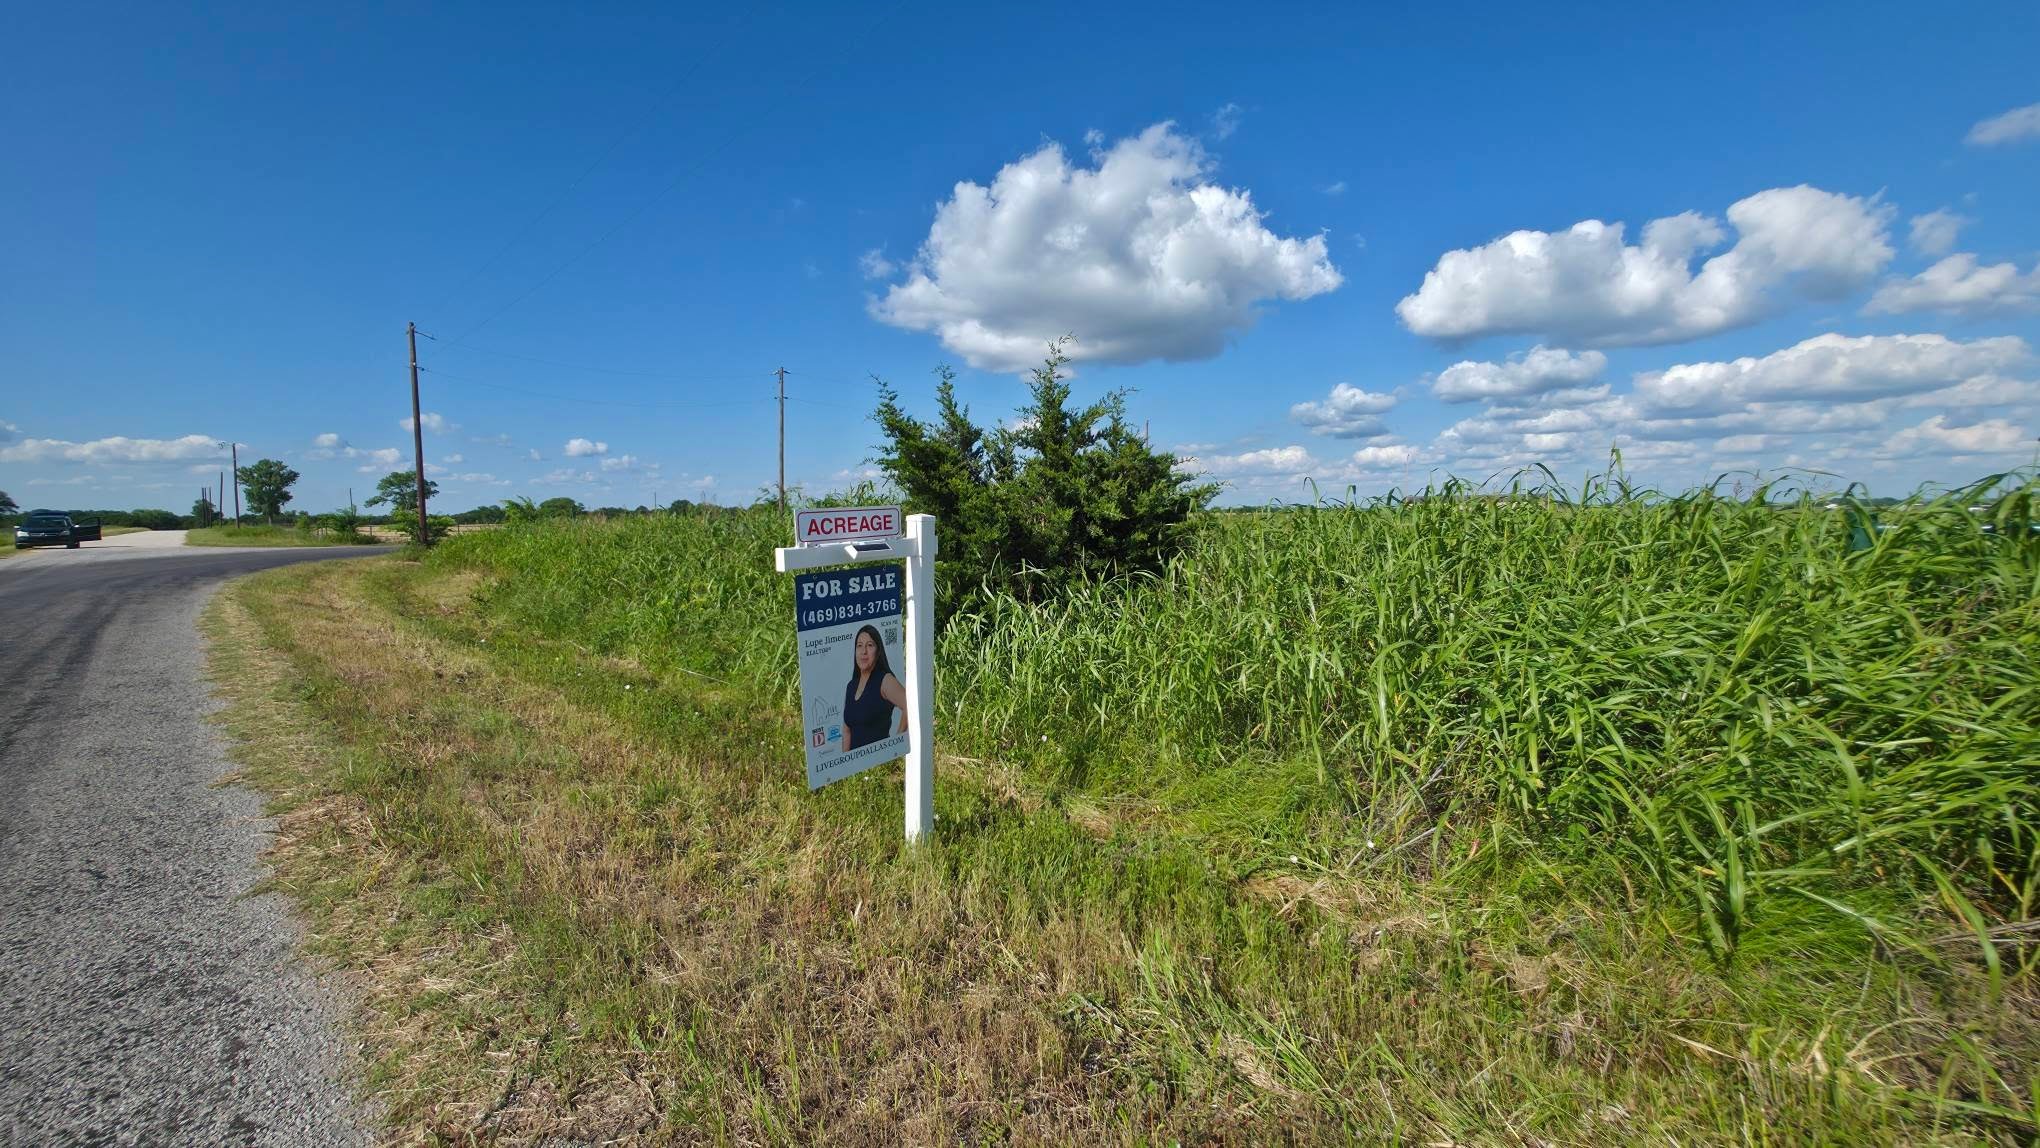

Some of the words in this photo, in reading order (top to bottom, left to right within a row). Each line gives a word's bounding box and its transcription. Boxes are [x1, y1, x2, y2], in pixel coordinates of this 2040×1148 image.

[807, 514, 893, 536] ACREAGE
[802, 579, 843, 600] FOR
[848, 572, 896, 594] SALE
[802, 598, 897, 626] (469)834-3766
[805, 639, 823, 649] Lupe
[824, 633, 854, 645] Jimenez
